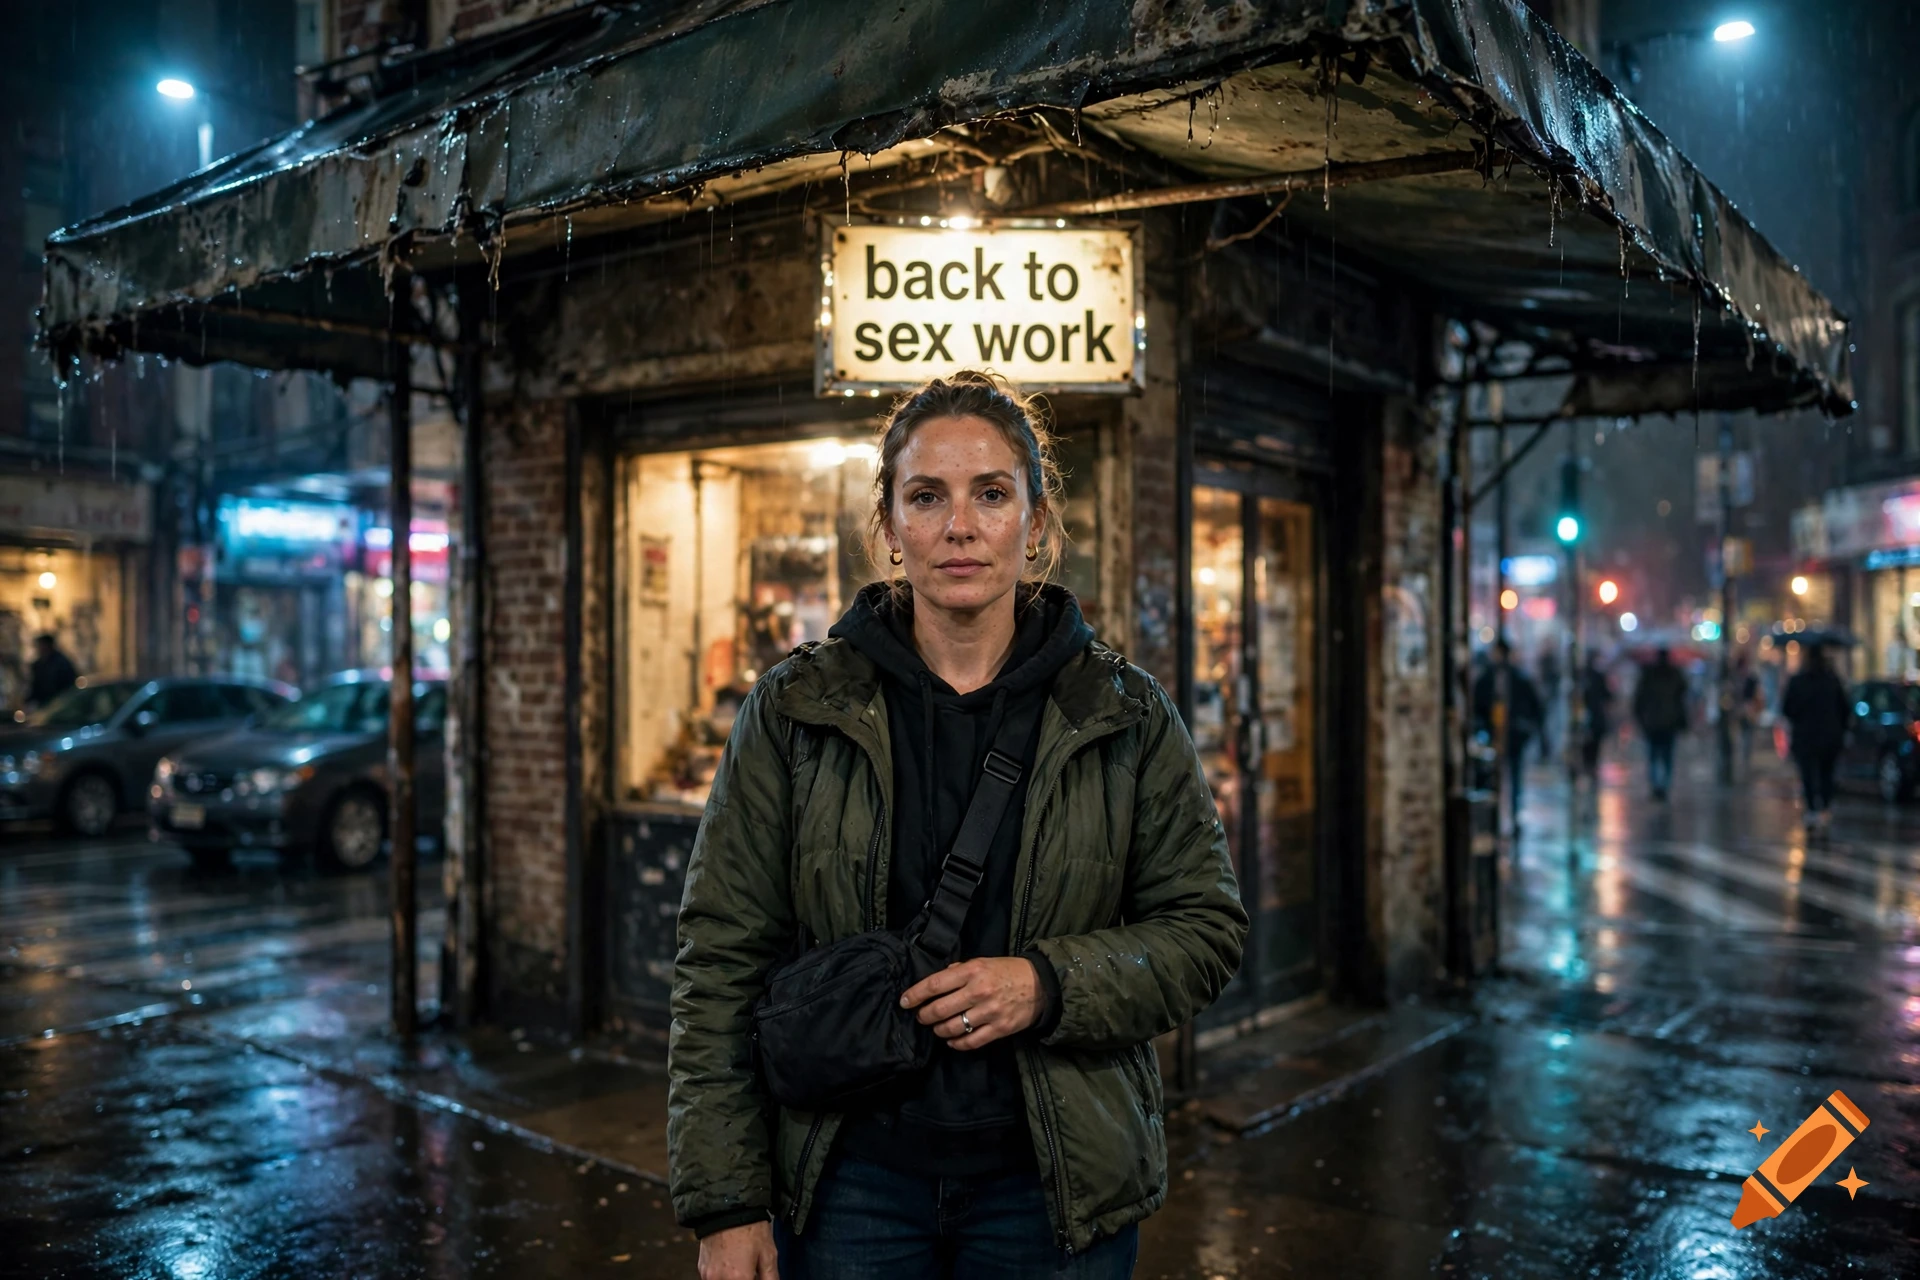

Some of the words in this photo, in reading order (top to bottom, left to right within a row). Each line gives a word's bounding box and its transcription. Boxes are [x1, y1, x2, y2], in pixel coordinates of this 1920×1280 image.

[866, 244, 1005, 301] back
[1024, 251, 1080, 302] to
[854, 321, 954, 363] sex
[973, 310, 1116, 363] work
